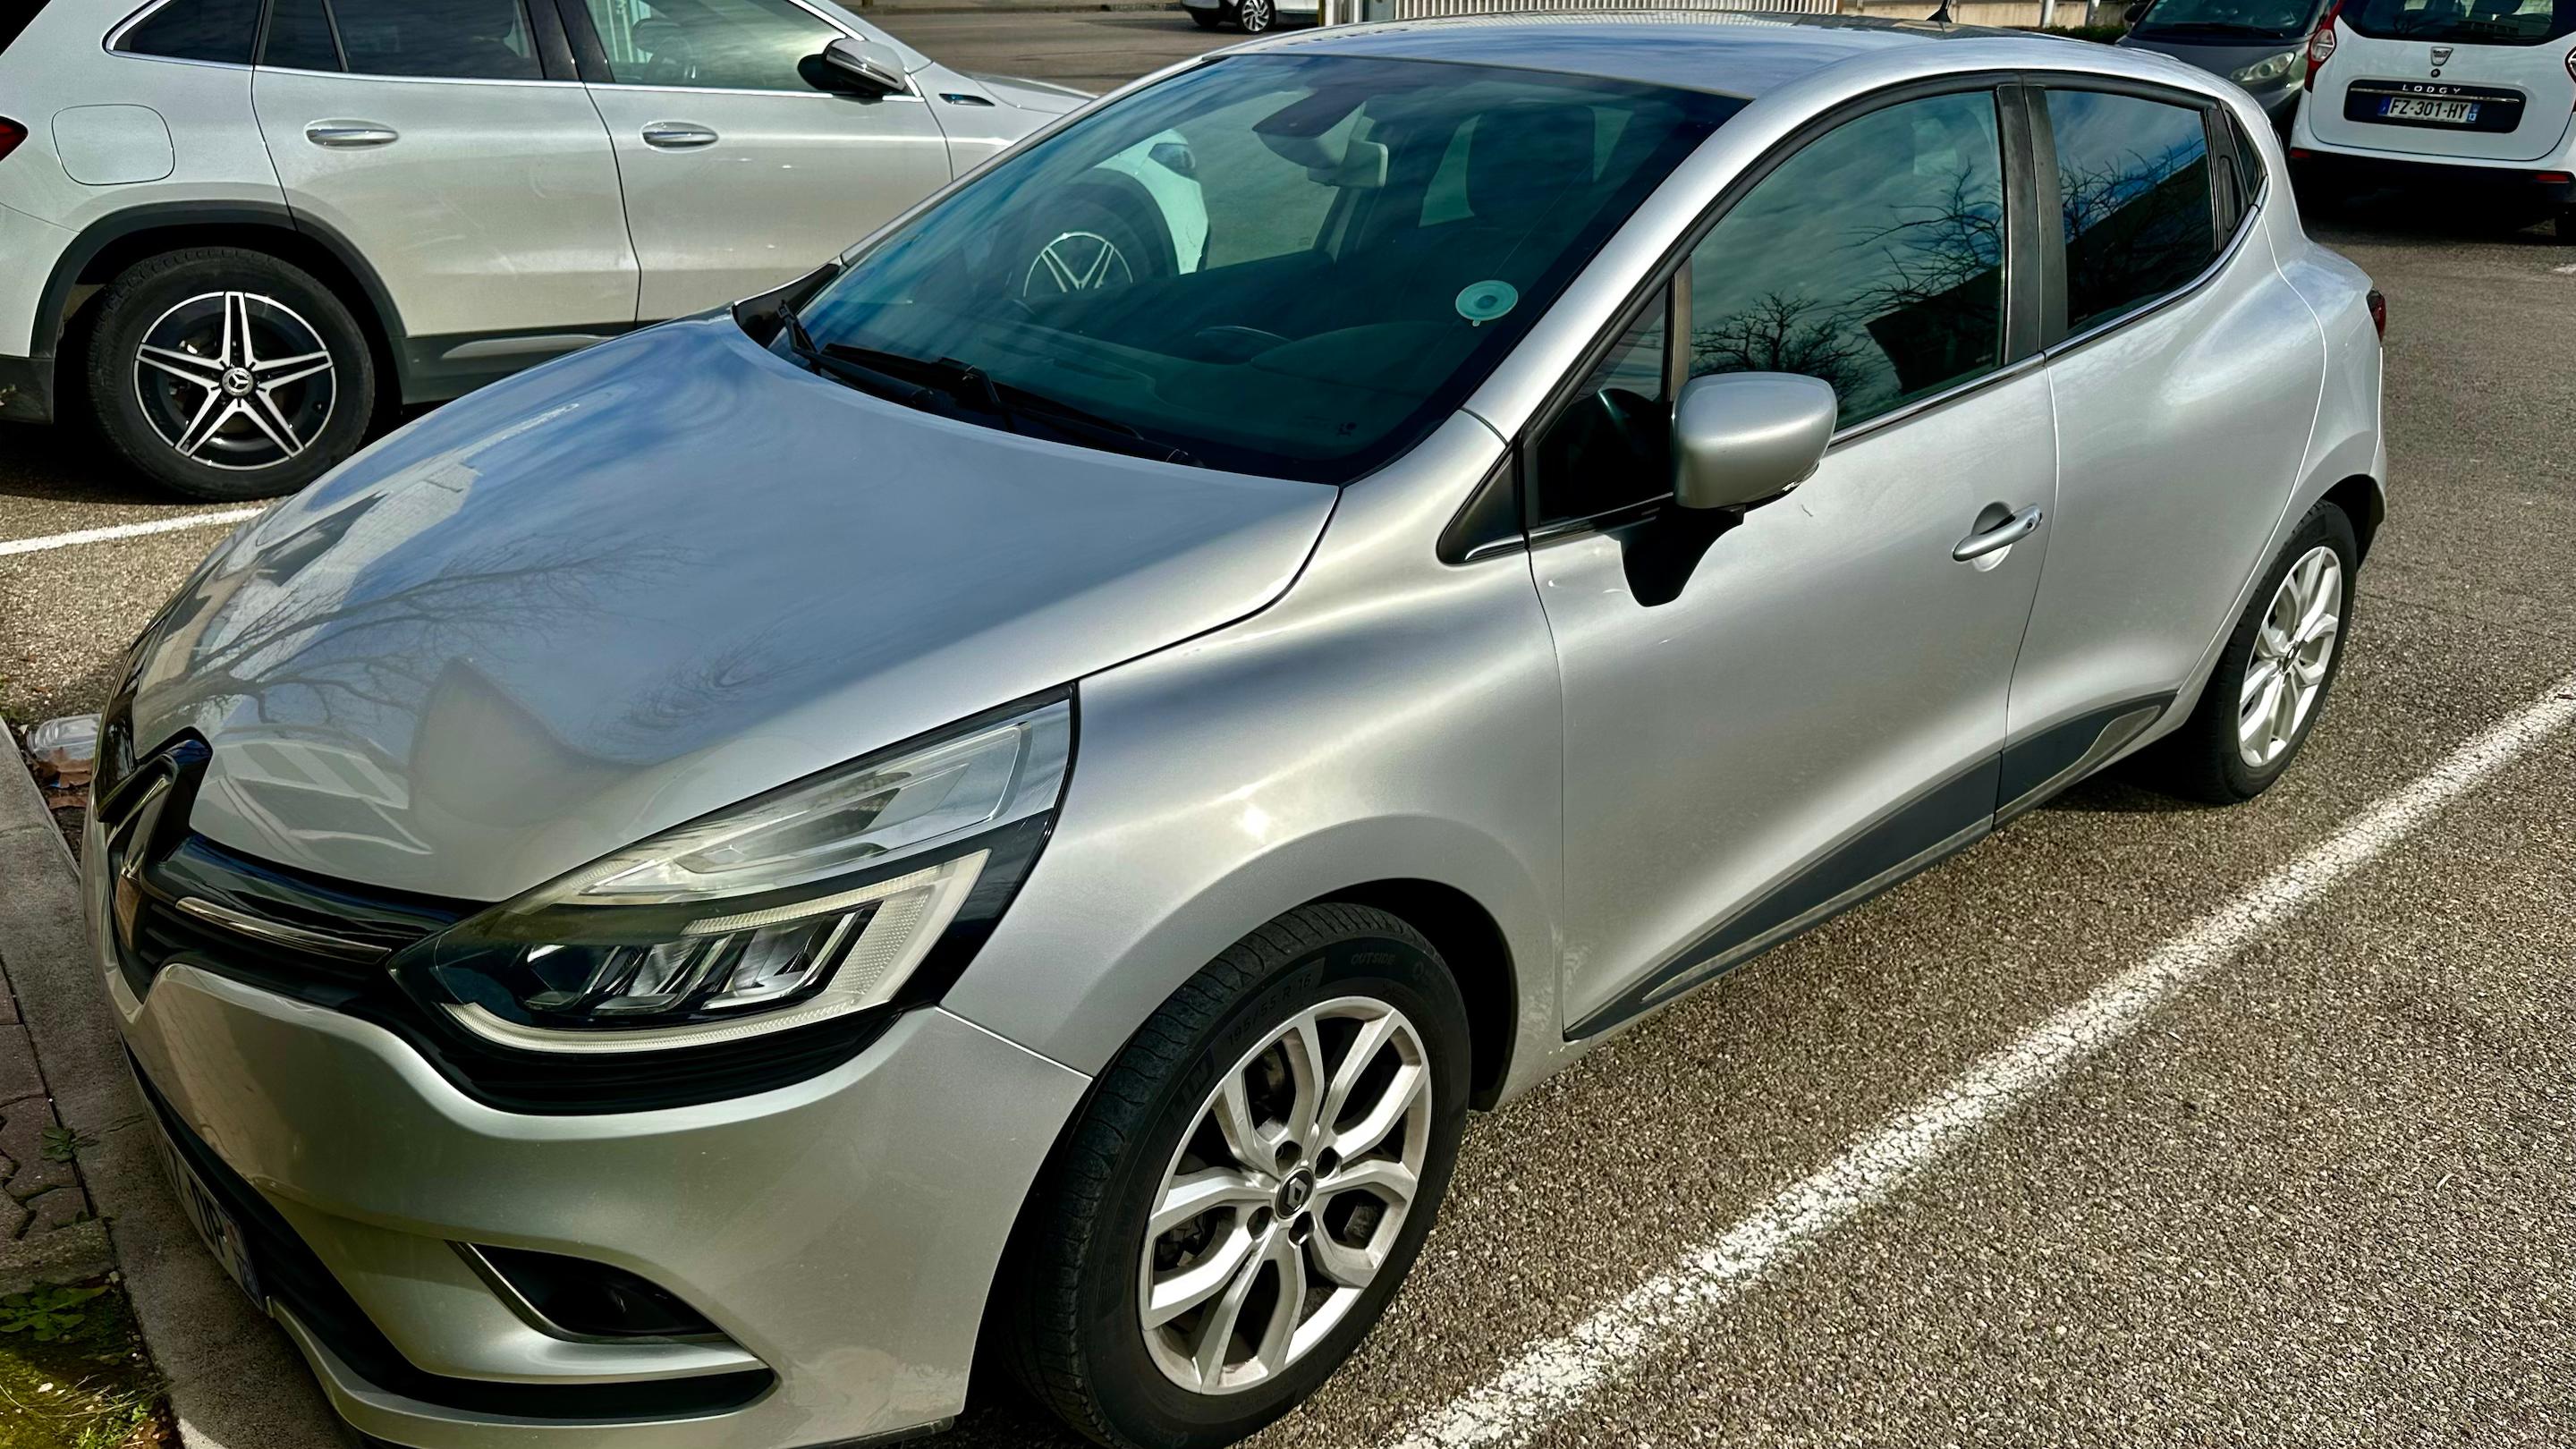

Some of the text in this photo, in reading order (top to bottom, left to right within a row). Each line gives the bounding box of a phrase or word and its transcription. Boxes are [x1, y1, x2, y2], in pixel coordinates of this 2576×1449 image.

[2402, 84, 2461, 94] LODGY
[2390, 99, 2468, 119] FZ-301-HY
[1351, 951, 1396, 966] OUTSIDE
[1282, 987, 1292, 1001] R
[1298, 971, 1312, 991] 16
